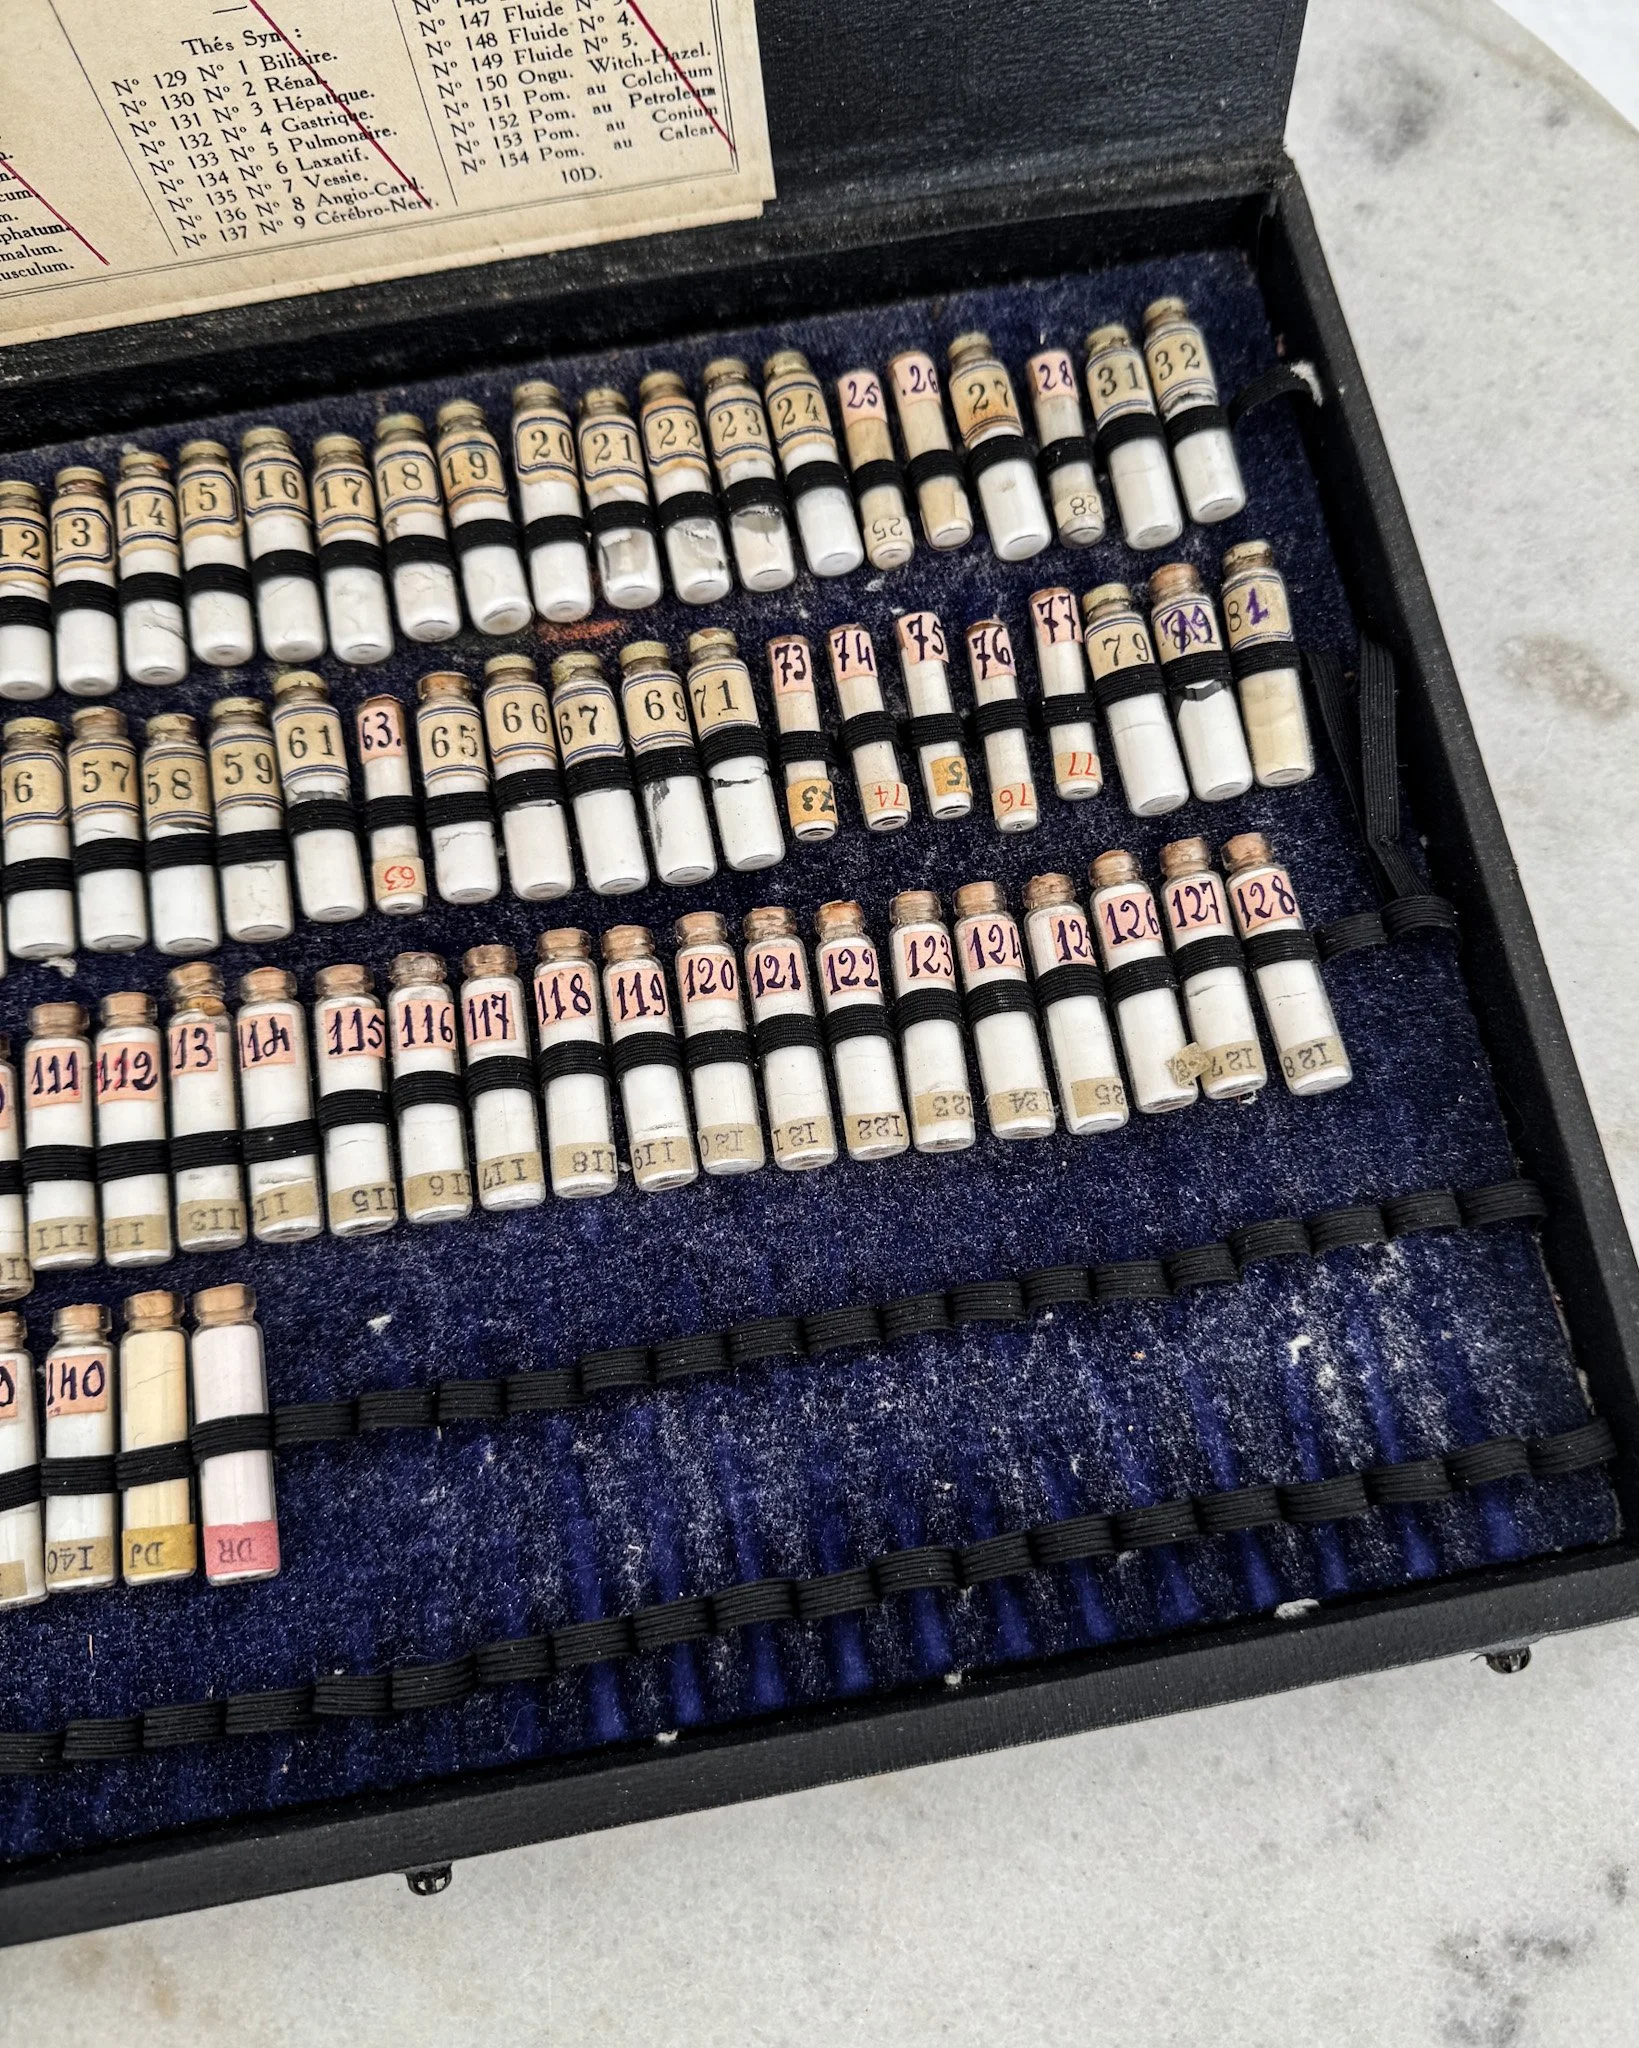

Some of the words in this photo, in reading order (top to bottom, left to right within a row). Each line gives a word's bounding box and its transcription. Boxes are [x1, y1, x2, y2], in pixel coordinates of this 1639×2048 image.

[460, 10, 490, 30] 147
[503, 0, 564, 24] Fluide
[466, 32, 498, 51] 148
[508, 22, 569, 45] Fluide
[617, 10, 635, 27] 4.
[181, 36, 234, 56] Thés
[472, 53, 503, 72] 149
[514, 43, 573, 65] Fluide
[621, 32, 638, 48] 5.
[153, 70, 187, 90] 129
[238, 60, 248, 75] 1
[259, 49, 338, 72] Biliaire.
[476, 73, 507, 92] 150
[518, 69, 573, 85] Ongu.
[586, 41, 711, 75] Witch-Hazel.
[161, 92, 195, 111] 130
[242, 81, 257, 97] 2
[482, 94, 511, 112] 151
[523, 89, 571, 105] Pom.
[586, 83, 606, 96] au
[621, 66, 713, 89] Colchicum
[489, 113, 520, 132] 152
[529, 108, 576, 124] Pom.
[592, 102, 613, 115] au
[628, 85, 716, 109] Petroleum
[170, 112, 202, 131] 131
[250, 101, 264, 117] 3
[273, 89, 375, 113] Hépatique.
[494, 132, 523, 150] 153
[533, 127, 580, 143] Pom.
[606, 120, 626, 133] au
[652, 105, 718, 124] Conium
[179, 132, 213, 151] 132
[260, 121, 272, 137] 4
[281, 110, 375, 133] Gastrique.
[188, 152, 219, 170] 133
[267, 142, 279, 157] 5
[288, 125, 397, 153] Pulmonaire.
[197, 170, 230, 189] 134
[276, 160, 289, 175] 6
[296, 147, 370, 172] Laxatif.
[500, 151, 529, 168] 154
[539, 146, 585, 162] Pom.
[613, 138, 633, 151] au
[206, 189, 238, 207] 135
[282, 179, 293, 194] 7
[303, 168, 369, 189] Vessie.
[561, 166, 602, 184] 10D.
[215, 207, 247, 225] 136
[292, 196, 306, 212] 8
[316, 176, 424, 208] Angio-Card.
[219, 225, 248, 243] 137
[294, 215, 306, 229] 9
[1037, 360, 1075, 391] 28
[1097, 361, 1145, 399] 31
[1154, 342, 1202, 382] 32
[776, 393, 821, 431] 24
[845, 379, 883, 411] 25
[967, 379, 1012, 416] 27
[656, 418, 703, 450] 22
[717, 406, 763, 441] 23
[529, 430, 575, 462] 20
[592, 432, 638, 466] 21
[255, 470, 300, 501] 16
[380, 462, 424, 501] 18
[446, 451, 490, 490] 19
[182, 482, 218, 517] 15
[320, 477, 364, 512] 17
[123, 498, 168, 532] 14
[906, 613, 947, 663] 75
[1036, 593, 1079, 644] 77
[773, 643, 809, 688] 73
[833, 630, 875, 673] 74
[971, 624, 1013, 682] 76
[1101, 631, 1151, 668] 79
[501, 701, 549, 736] 66
[557, 705, 600, 746] 67
[644, 688, 688, 724] 69
[287, 724, 337, 760] 61
[430, 722, 480, 760] 65
[82, 760, 131, 794] 57
[224, 751, 274, 786] 59
[1067, 751, 1098, 778] 77
[146, 768, 194, 806] 58
[801, 784, 838, 814] 73
[873, 782, 906, 810] 74
[998, 782, 1034, 813] 76
[383, 864, 417, 892] 63
[1105, 895, 1161, 946] 126
[1171, 880, 1223, 929] 127
[1236, 874, 1297, 929] 128
[751, 951, 802, 1000] 121
[825, 947, 880, 996] 122
[906, 934, 955, 979] 123
[616, 971, 667, 1021] 119
[683, 956, 735, 1003] 120
[467, 992, 510, 1041] 117
[537, 973, 593, 1026] 118
[328, 1007, 386, 1056] 115
[401, 1003, 454, 1048] 116
[31, 1050, 80, 1096] 111
[47, 1359, 107, 1407] 140
